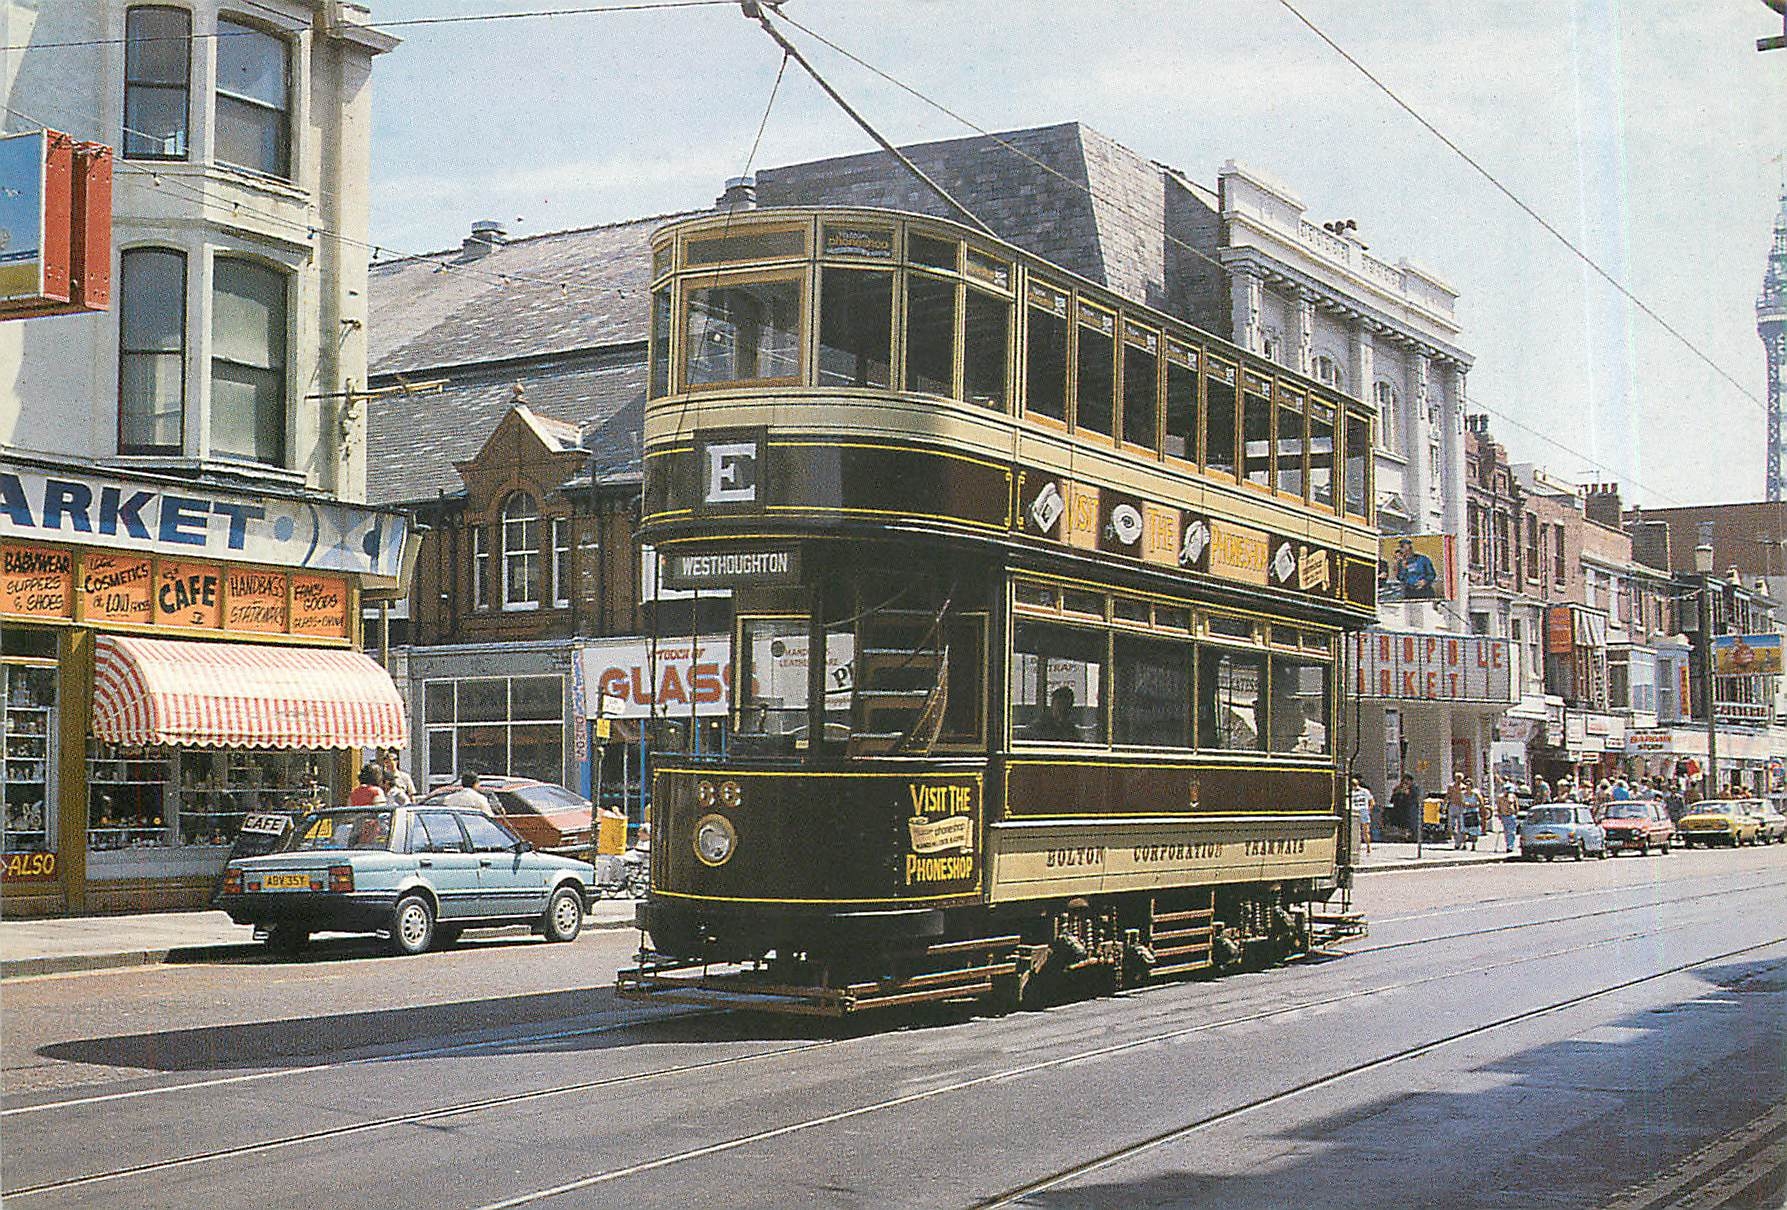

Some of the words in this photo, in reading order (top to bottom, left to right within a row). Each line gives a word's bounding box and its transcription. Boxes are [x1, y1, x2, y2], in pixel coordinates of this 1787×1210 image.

[705, 443, 757, 502] E
[1062, 479, 1099, 534] VISIT
[1149, 507, 1175, 553] THE
[682, 552, 789, 576] WESTHOUGHTON
[7, 576, 61, 595] SLIPPERS
[84, 563, 149, 594] COSMETICS
[230, 575, 285, 598] HANDBAGS
[27, 594, 63, 611] SHOES
[106, 593, 129, 613] LOW
[159, 575, 217, 614] CAFE
[294, 583, 325, 601] FANCY
[304, 594, 338, 612] GOODS
[910, 783, 947, 816] VISIT
[948, 785, 972, 816] THE
[244, 815, 282, 831] CAFE
[8, 853, 55, 876] ALSO
[1046, 845, 1105, 868] BOLTON
[1133, 841, 1224, 863] CORPORATION
[906, 854, 973, 886] PHONESHOP
